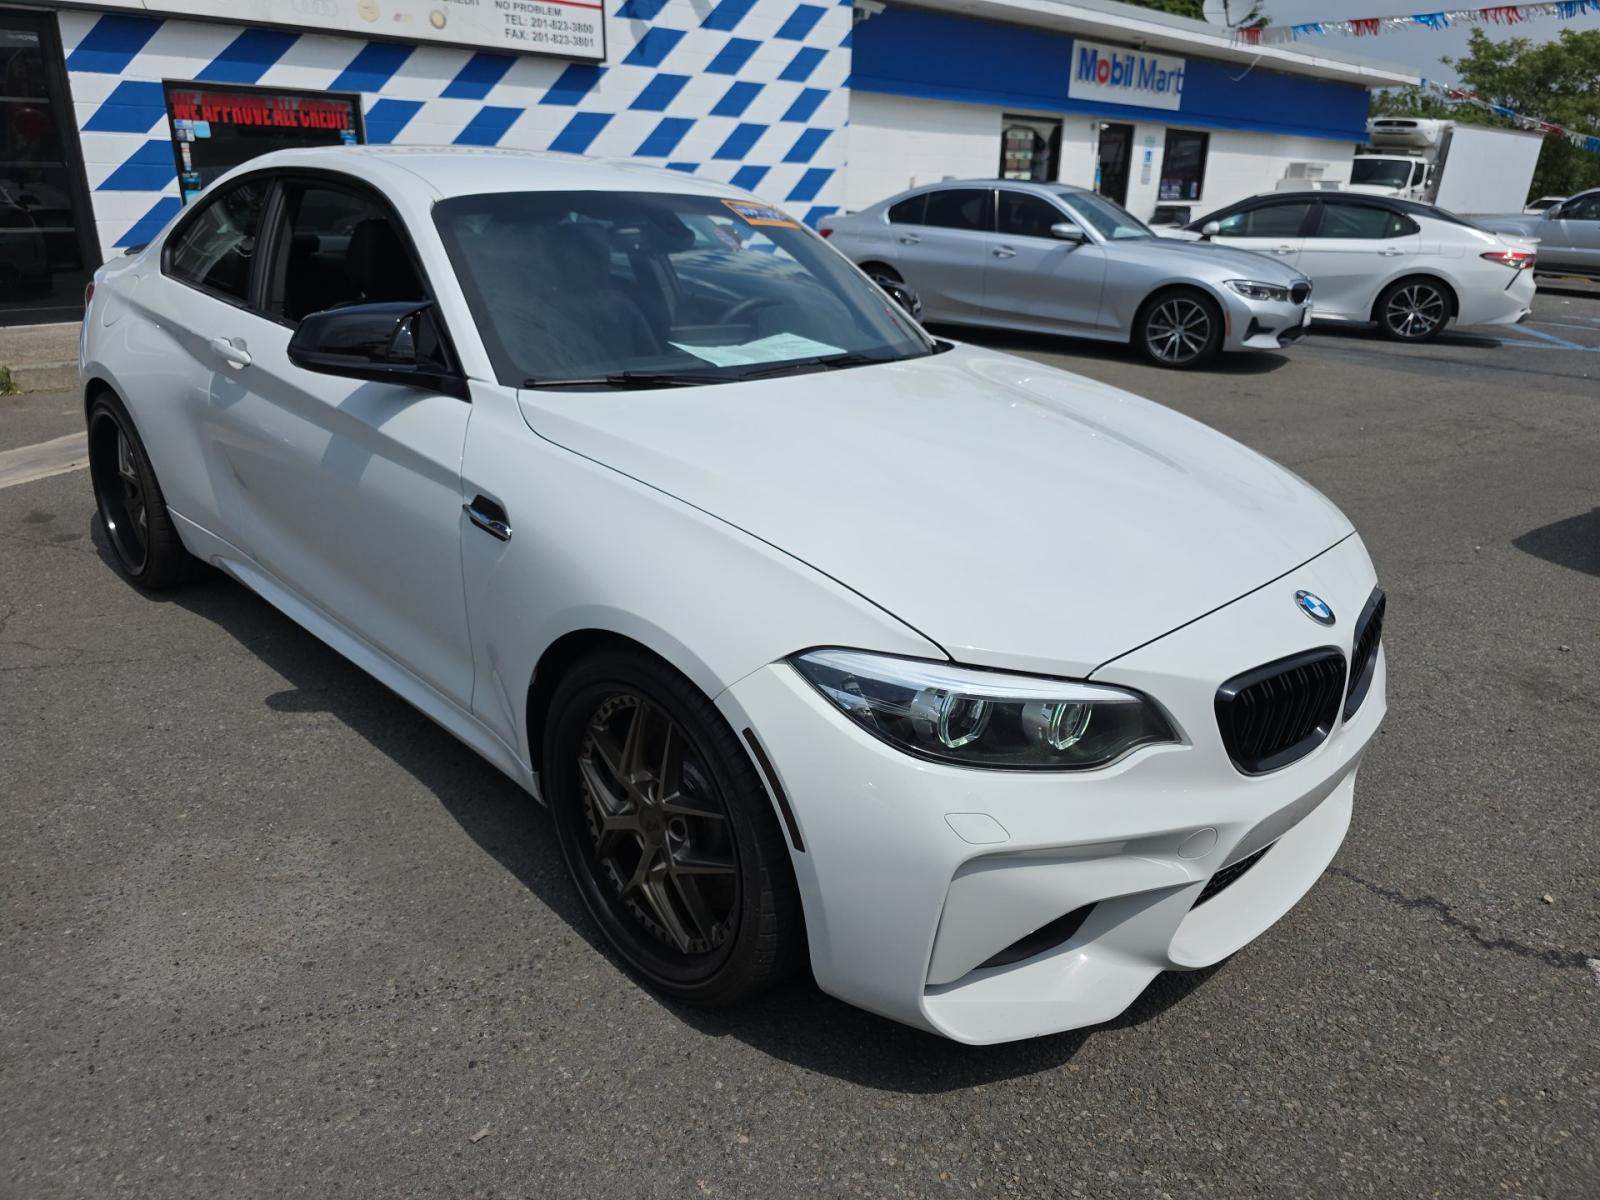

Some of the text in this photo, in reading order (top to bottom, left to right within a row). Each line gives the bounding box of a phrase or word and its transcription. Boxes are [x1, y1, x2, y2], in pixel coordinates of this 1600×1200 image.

[495, 0, 562, 17] NO PROBLEM
[504, 14, 528, 27] TEL:
[505, 28, 529, 41] FAX:
[1078, 47, 1184, 94] Mobil Mart
[172, 91, 349, 130] WE APPROVE ALL CREDIT
